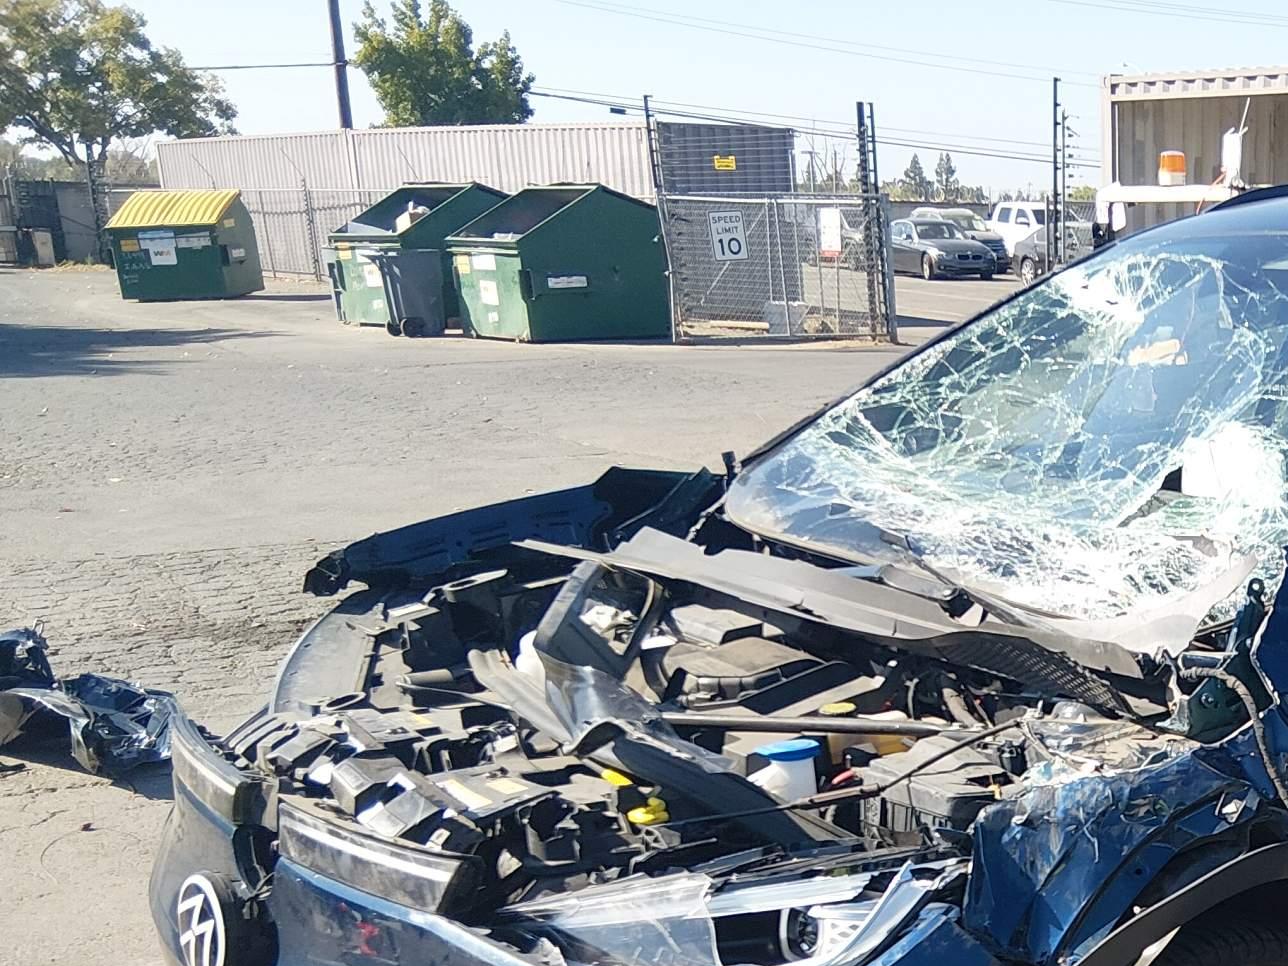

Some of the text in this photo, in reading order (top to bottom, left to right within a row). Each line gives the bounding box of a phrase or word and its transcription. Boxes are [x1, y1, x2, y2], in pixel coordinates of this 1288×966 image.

[711, 215, 741, 224] SPEED
[716, 226, 739, 235] LIMIT
[718, 237, 742, 256] 10
